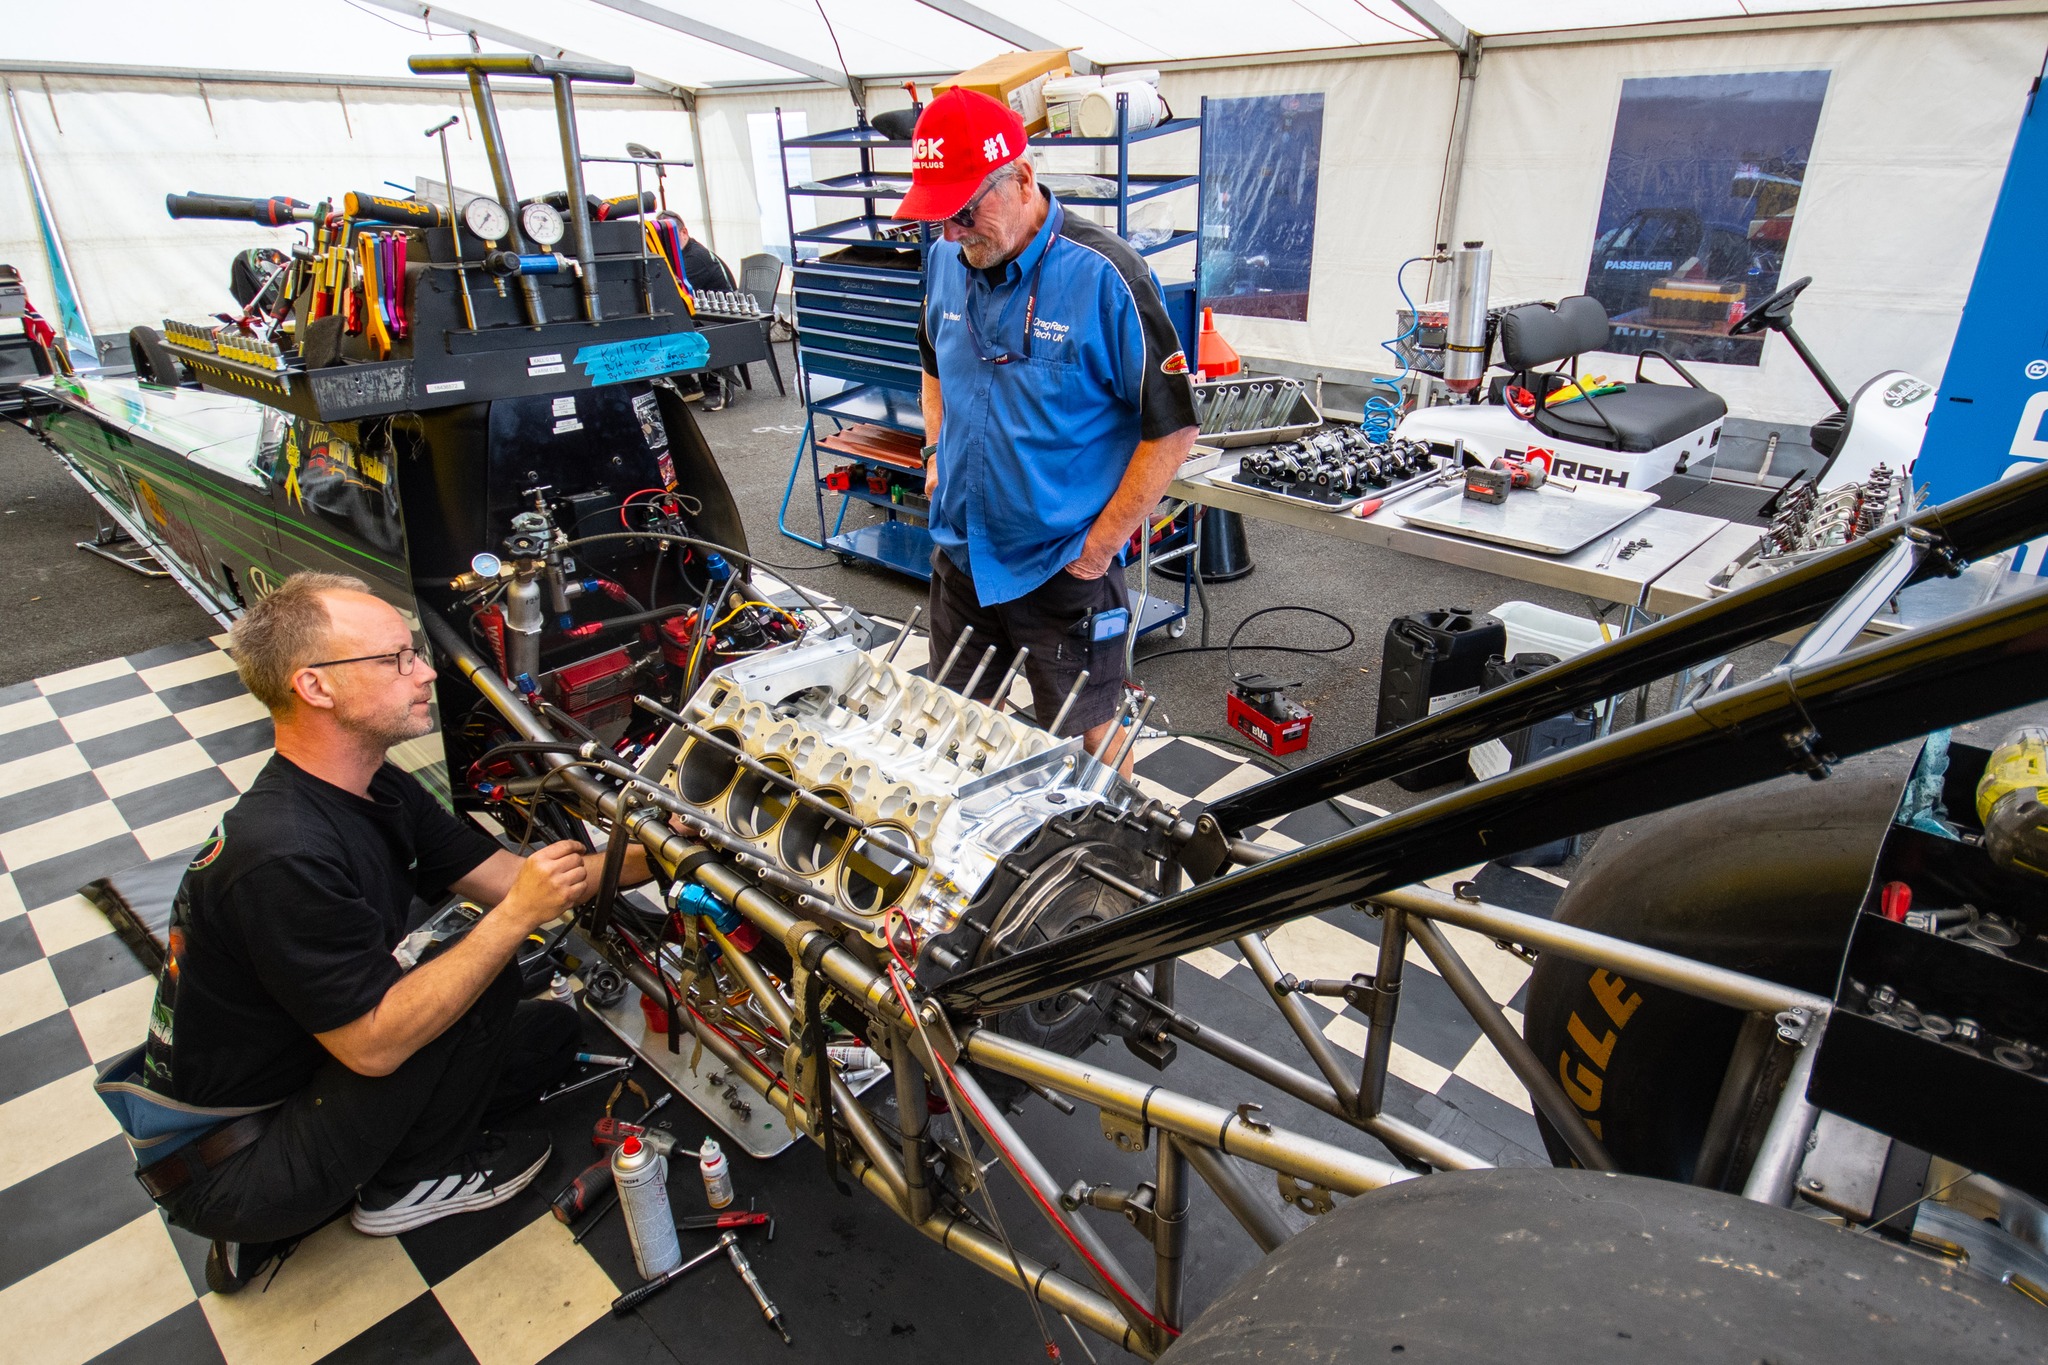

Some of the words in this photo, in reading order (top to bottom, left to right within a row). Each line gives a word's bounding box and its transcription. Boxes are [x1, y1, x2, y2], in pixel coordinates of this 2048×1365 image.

[983, 133, 1010, 163] #1
[921, 161, 944, 169] PLUGS
[1604, 260, 1673, 271] PASSENGER
[1033, 328, 1051, 341] Tech
[1052, 333, 1064, 343] UK
[1252, 725, 1268, 743] BVA
[1559, 967, 1644, 1142] GLE
